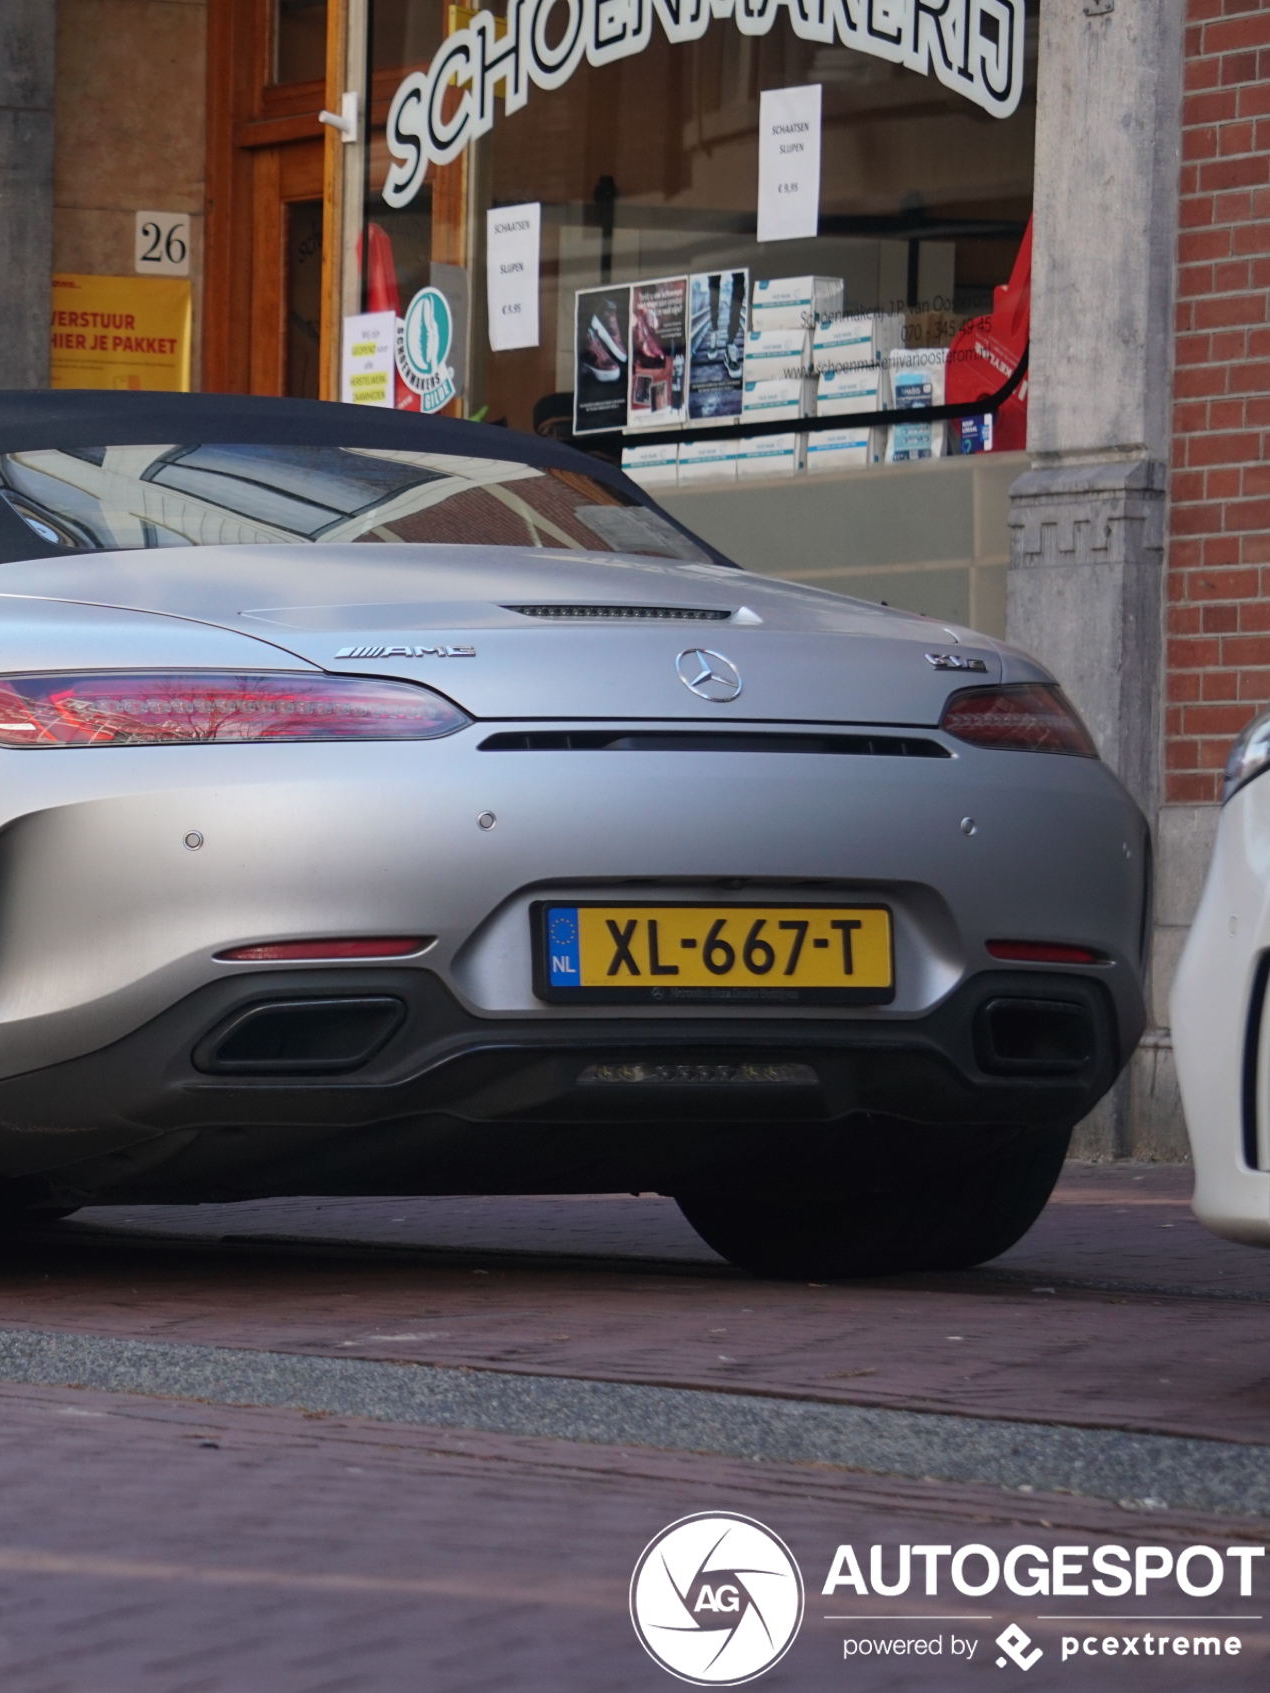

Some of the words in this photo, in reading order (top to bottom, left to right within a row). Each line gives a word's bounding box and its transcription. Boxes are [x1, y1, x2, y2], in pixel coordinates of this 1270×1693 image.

[772, 122, 809, 135] SCHAATSEN
[494, 220, 530, 234] SCHAATSEN
[140, 222, 186, 264] 26
[801, 303, 884, 328] Schoenmakerij
[908, 300, 929, 315] van
[900, 325, 922, 343] 070
[935, 320, 956, 339] 345
[90, 335, 108, 351] JE
[113, 336, 177, 354] PAKKET
[396, 327, 440, 391] SCHOENMAKERS
[424, 379, 451, 411] GILDE
[380, 646, 476, 657] AMG
[605, 919, 861, 976] XL-667-T
[552, 956, 576, 973] NL
[670, 987, 731, 999] Mercedes-Benz
